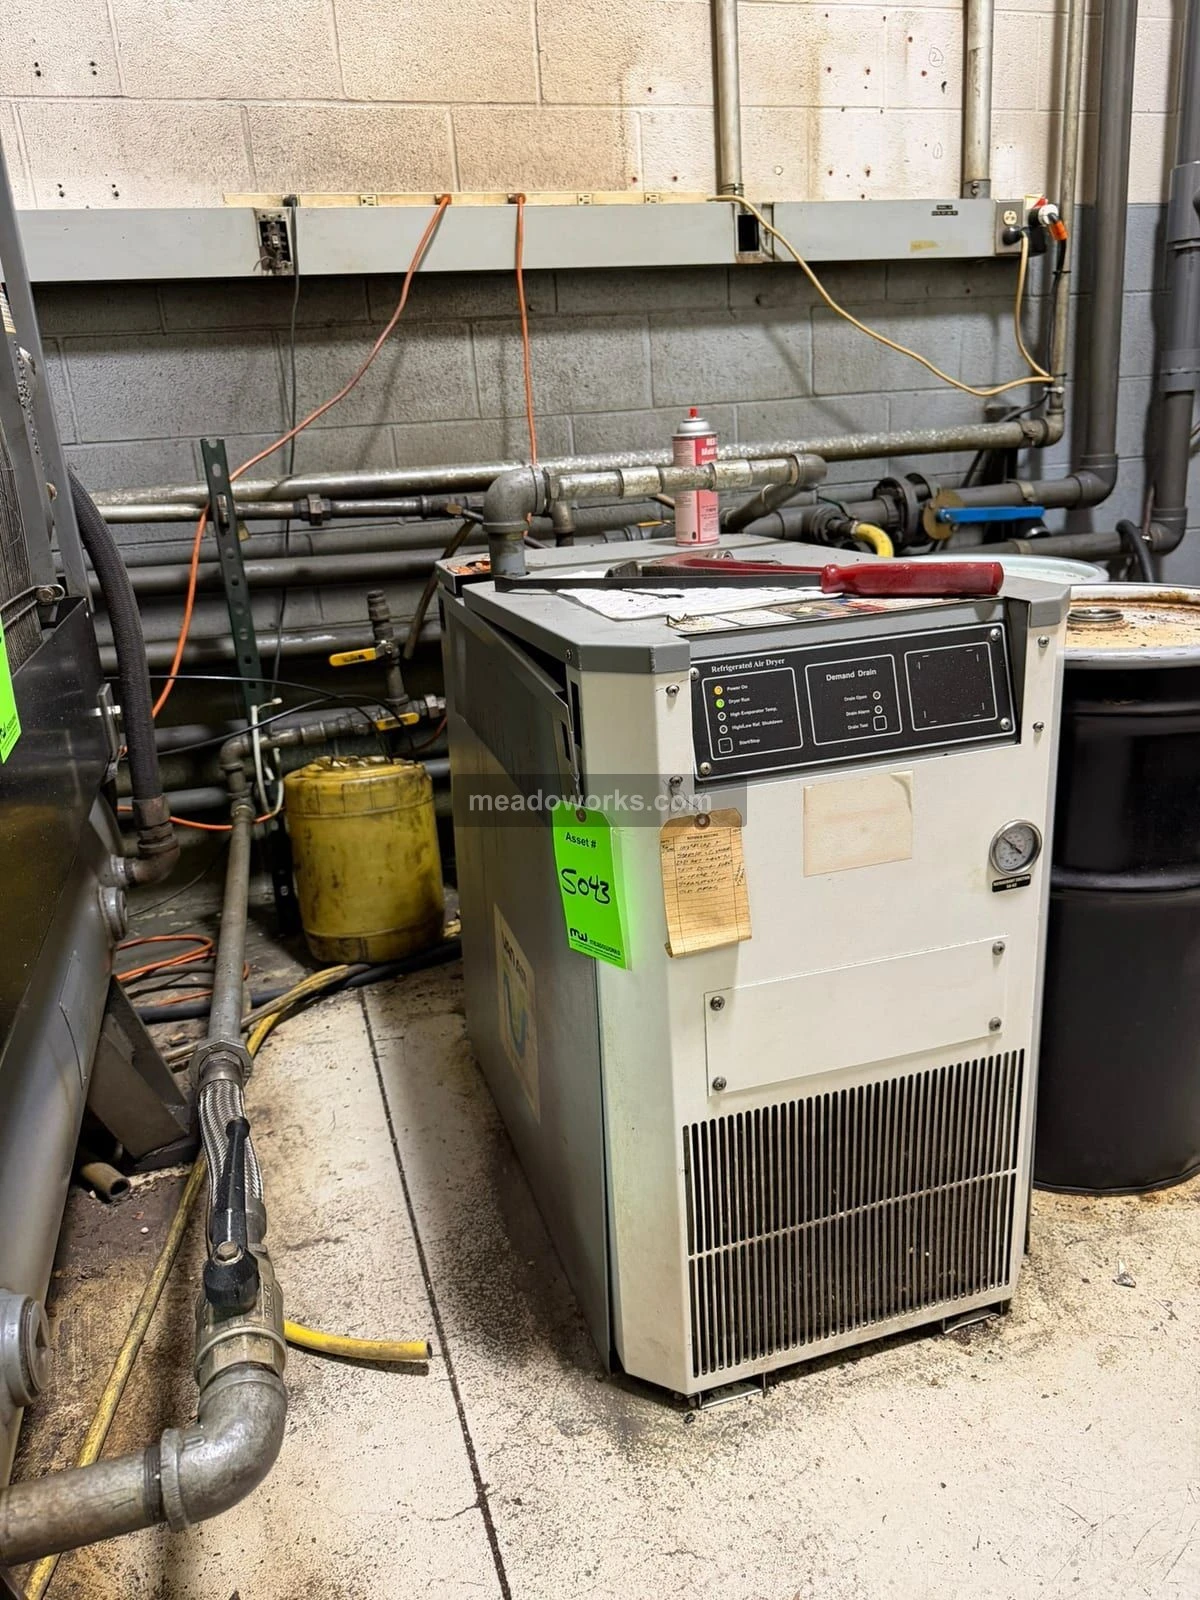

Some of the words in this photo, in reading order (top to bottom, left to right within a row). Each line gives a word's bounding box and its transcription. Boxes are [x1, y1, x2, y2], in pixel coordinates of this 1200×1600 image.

[711, 661, 753, 673] Refrigerated
[753, 660, 765, 668] Air
[765, 658, 785, 668] Dryer
[826, 671, 855, 681] Demand
[857, 668, 877, 677] Drain
[565, 832, 590, 848] Asset
[590, 839, 597, 849] #
